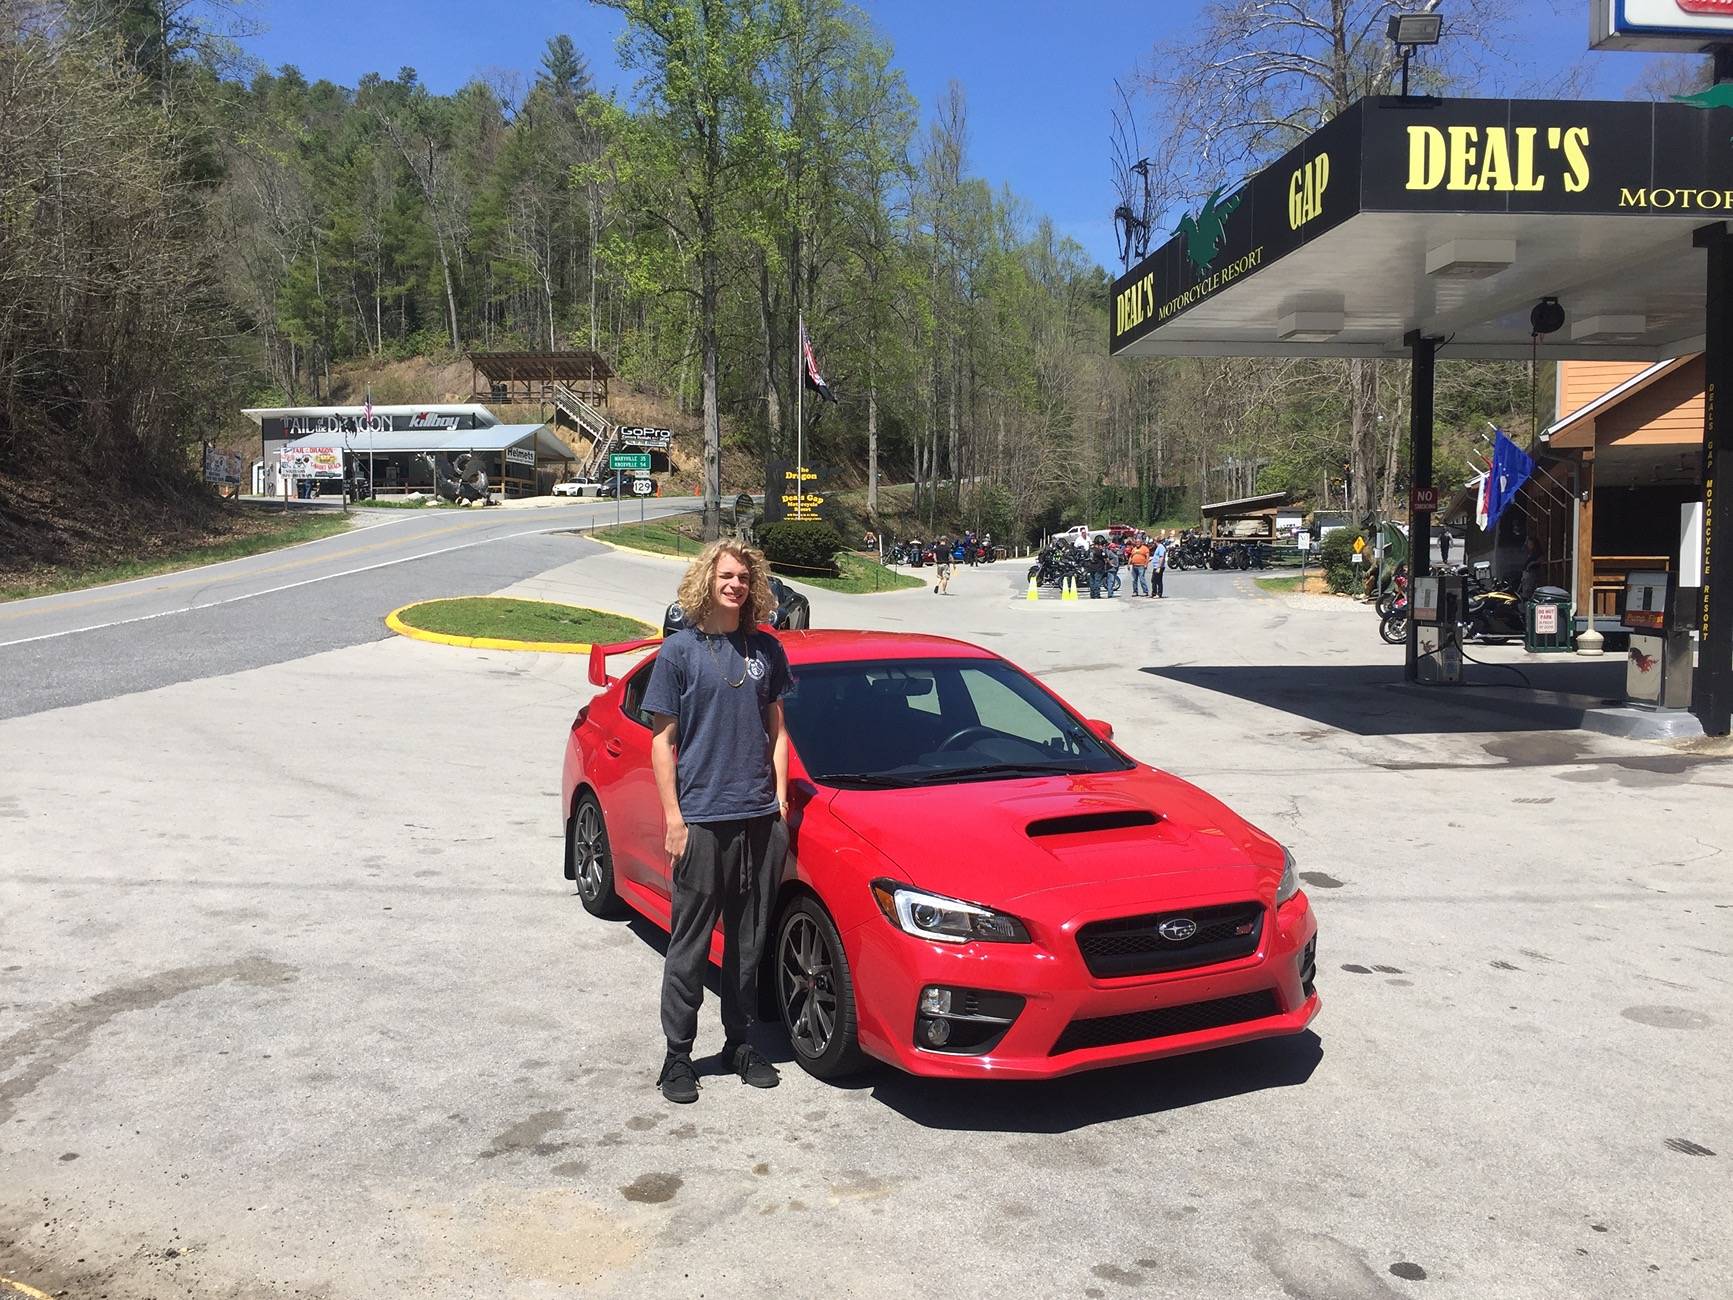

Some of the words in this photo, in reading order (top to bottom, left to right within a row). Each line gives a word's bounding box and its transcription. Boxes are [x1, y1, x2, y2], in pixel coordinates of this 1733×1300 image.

[1405, 125, 1590, 193] DEAL'S
[1288, 152, 1330, 231] GAP
[1158, 274, 1220, 321] MOTORCYCLE
[1221, 246, 1264, 284] RESORT
[1116, 271, 1154, 337] DEAL'S
[280, 415, 315, 438] TAIL
[409, 412, 460, 431] killboy
[621, 426, 670, 438] GoPro
[507, 447, 534, 461] Helmets
[634, 482, 650, 491] 129
[1417, 490, 1433, 501] NO
[806, 494, 824, 504] Gap
[1705, 479, 1713, 574] MOTORCYCLE
